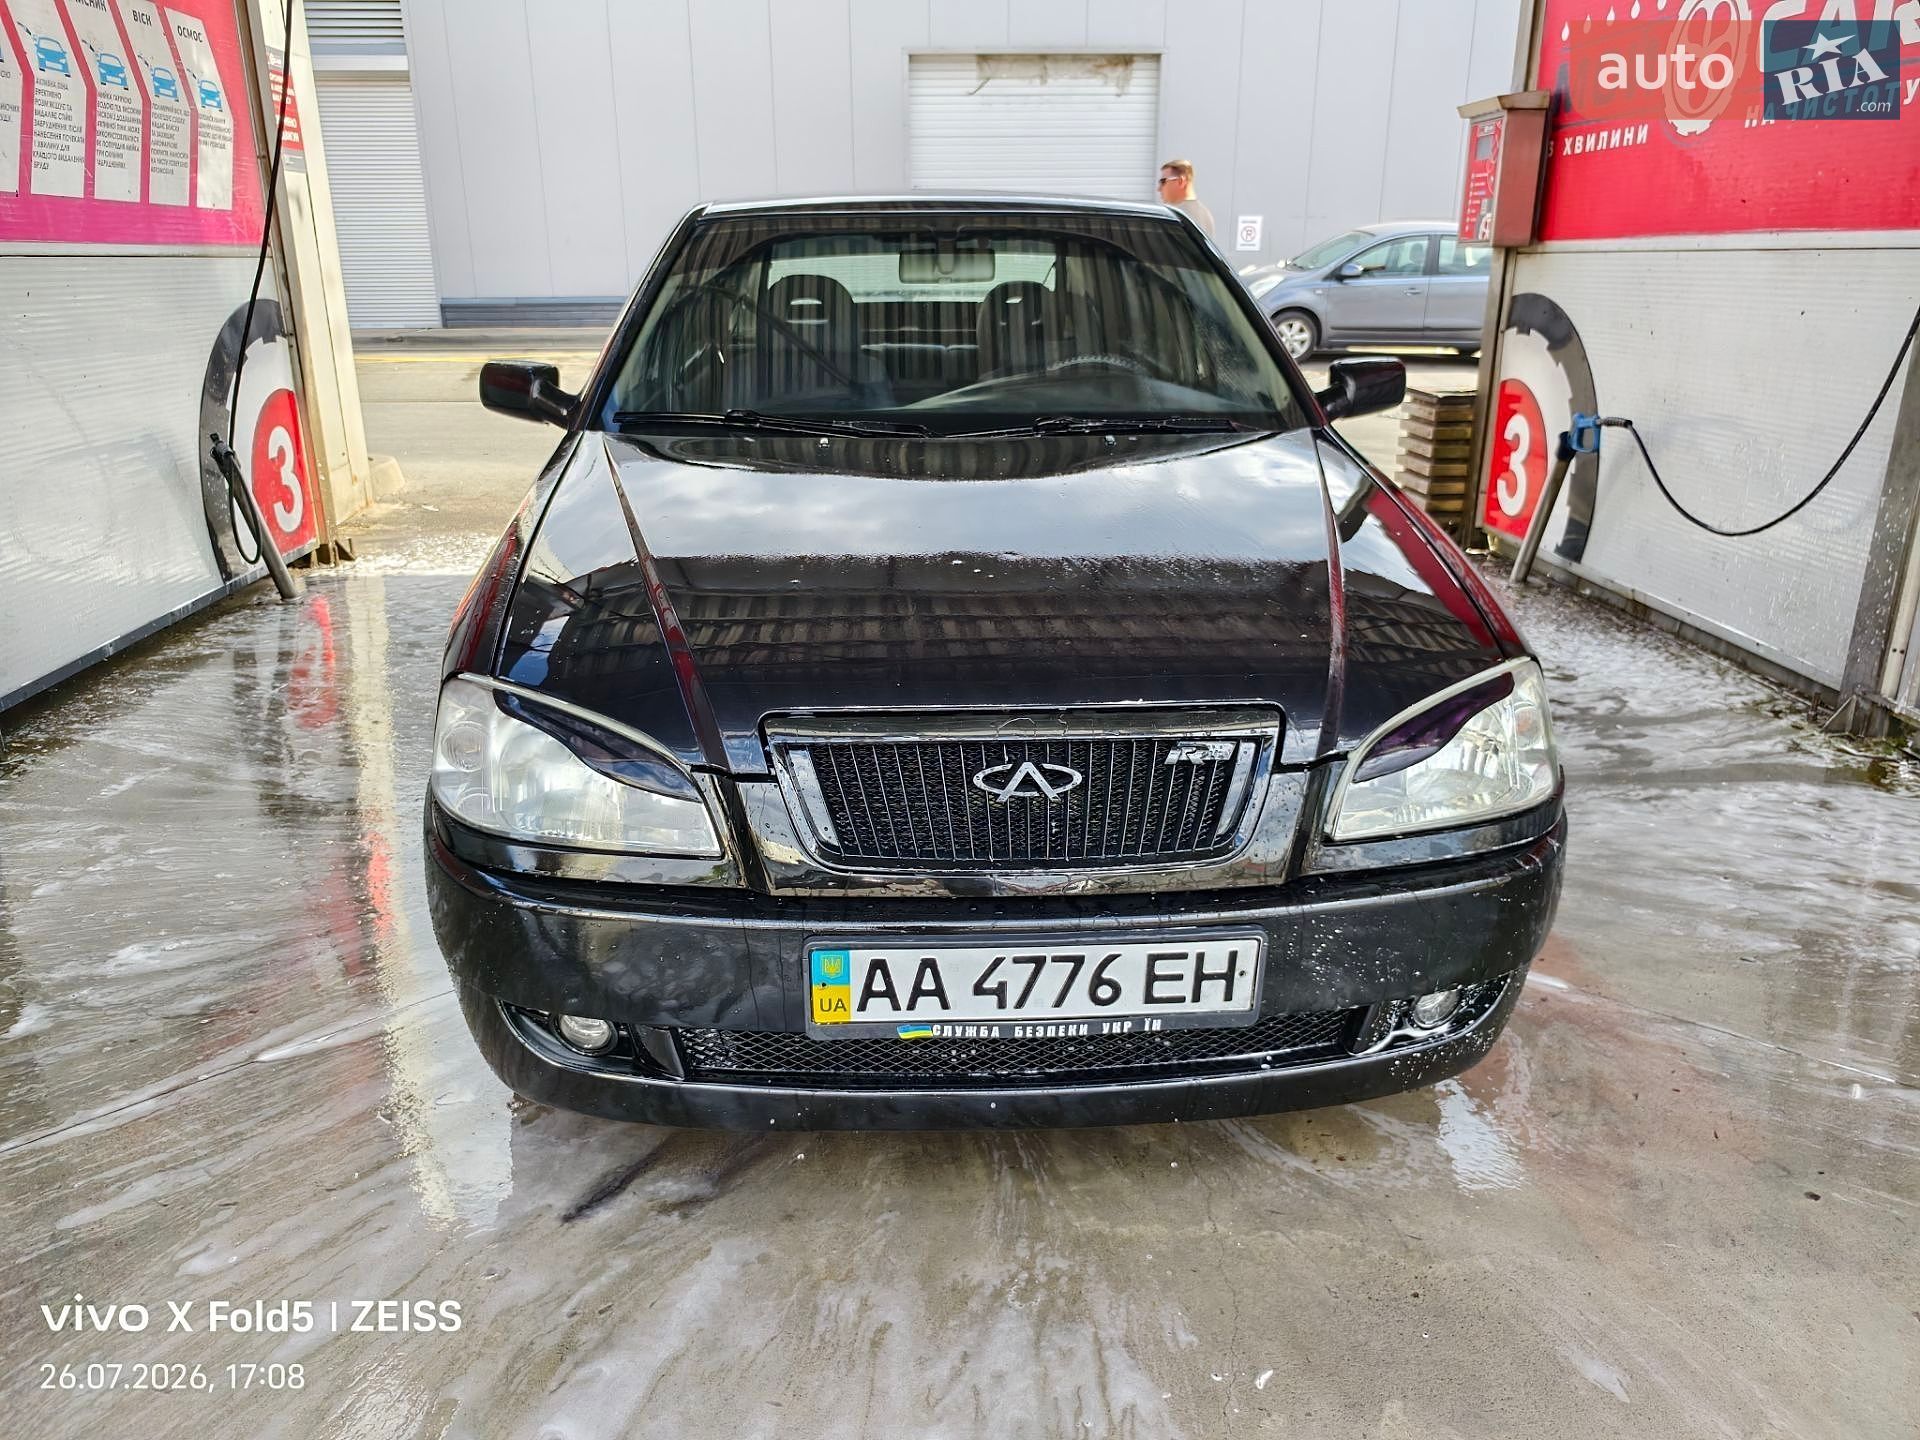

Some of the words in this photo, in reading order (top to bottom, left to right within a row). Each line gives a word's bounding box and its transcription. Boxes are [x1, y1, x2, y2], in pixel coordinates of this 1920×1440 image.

[177, 24, 203, 43] ОСМОС
[1562, 123, 1649, 156] ХВИЛИНИ
[268, 426, 303, 532] 3
[1497, 413, 1530, 516] 3
[819, 998, 847, 1012] UA
[857, 958, 950, 1012] AA
[973, 954, 1122, 1010] 4776
[1144, 950, 1238, 1004] EH
[932, 1015, 1000, 1037] СЛУЖБА
[1014, 1014, 1088, 1038] БЕЗПЕКИ
